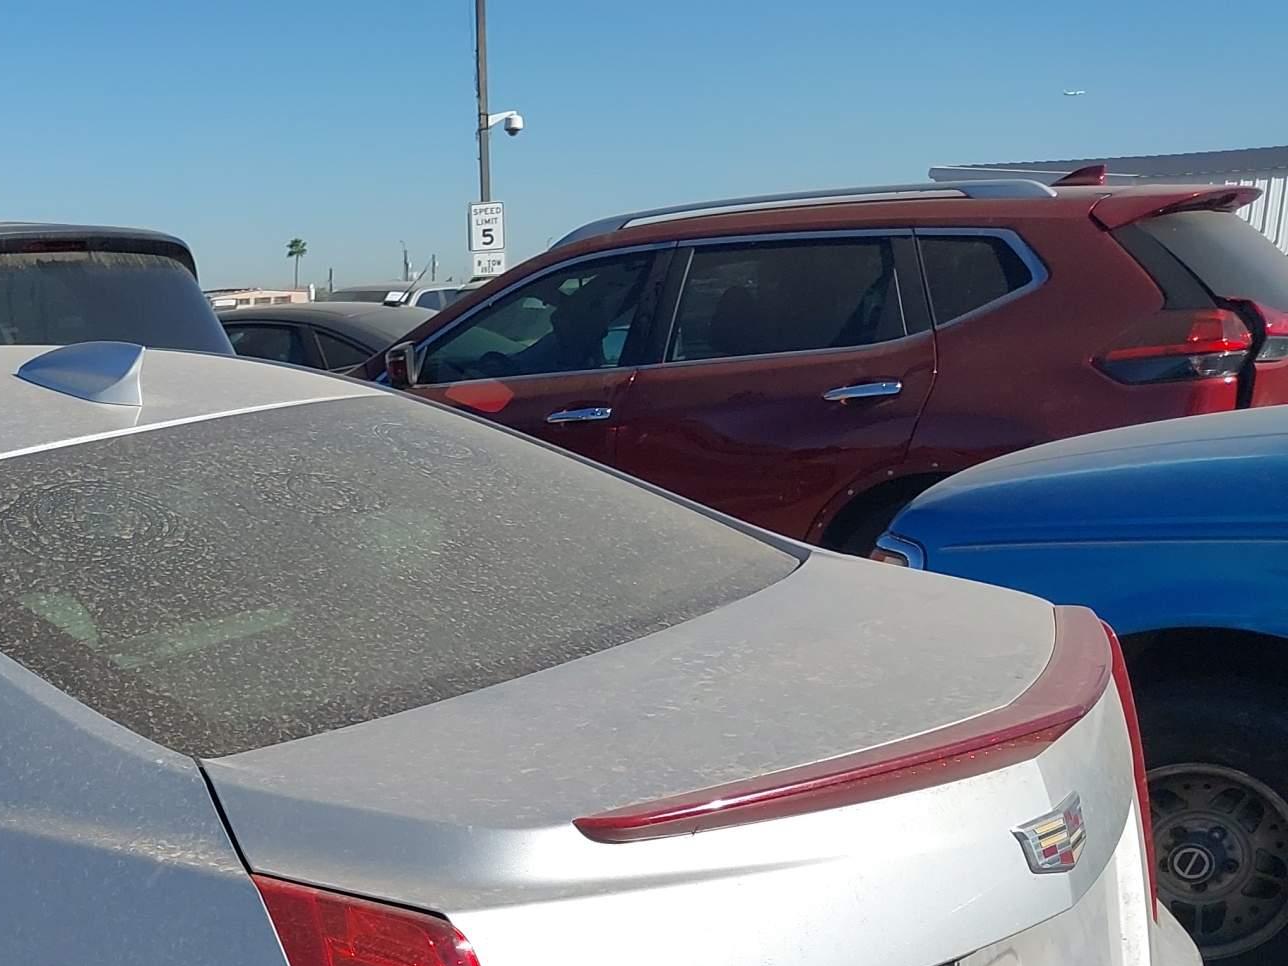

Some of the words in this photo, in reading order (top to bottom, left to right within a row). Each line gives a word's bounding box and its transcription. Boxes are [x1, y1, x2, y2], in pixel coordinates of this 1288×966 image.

[473, 207, 502, 216] SPEED
[476, 217, 498, 226] LIMIT
[482, 228, 494, 246] 5
